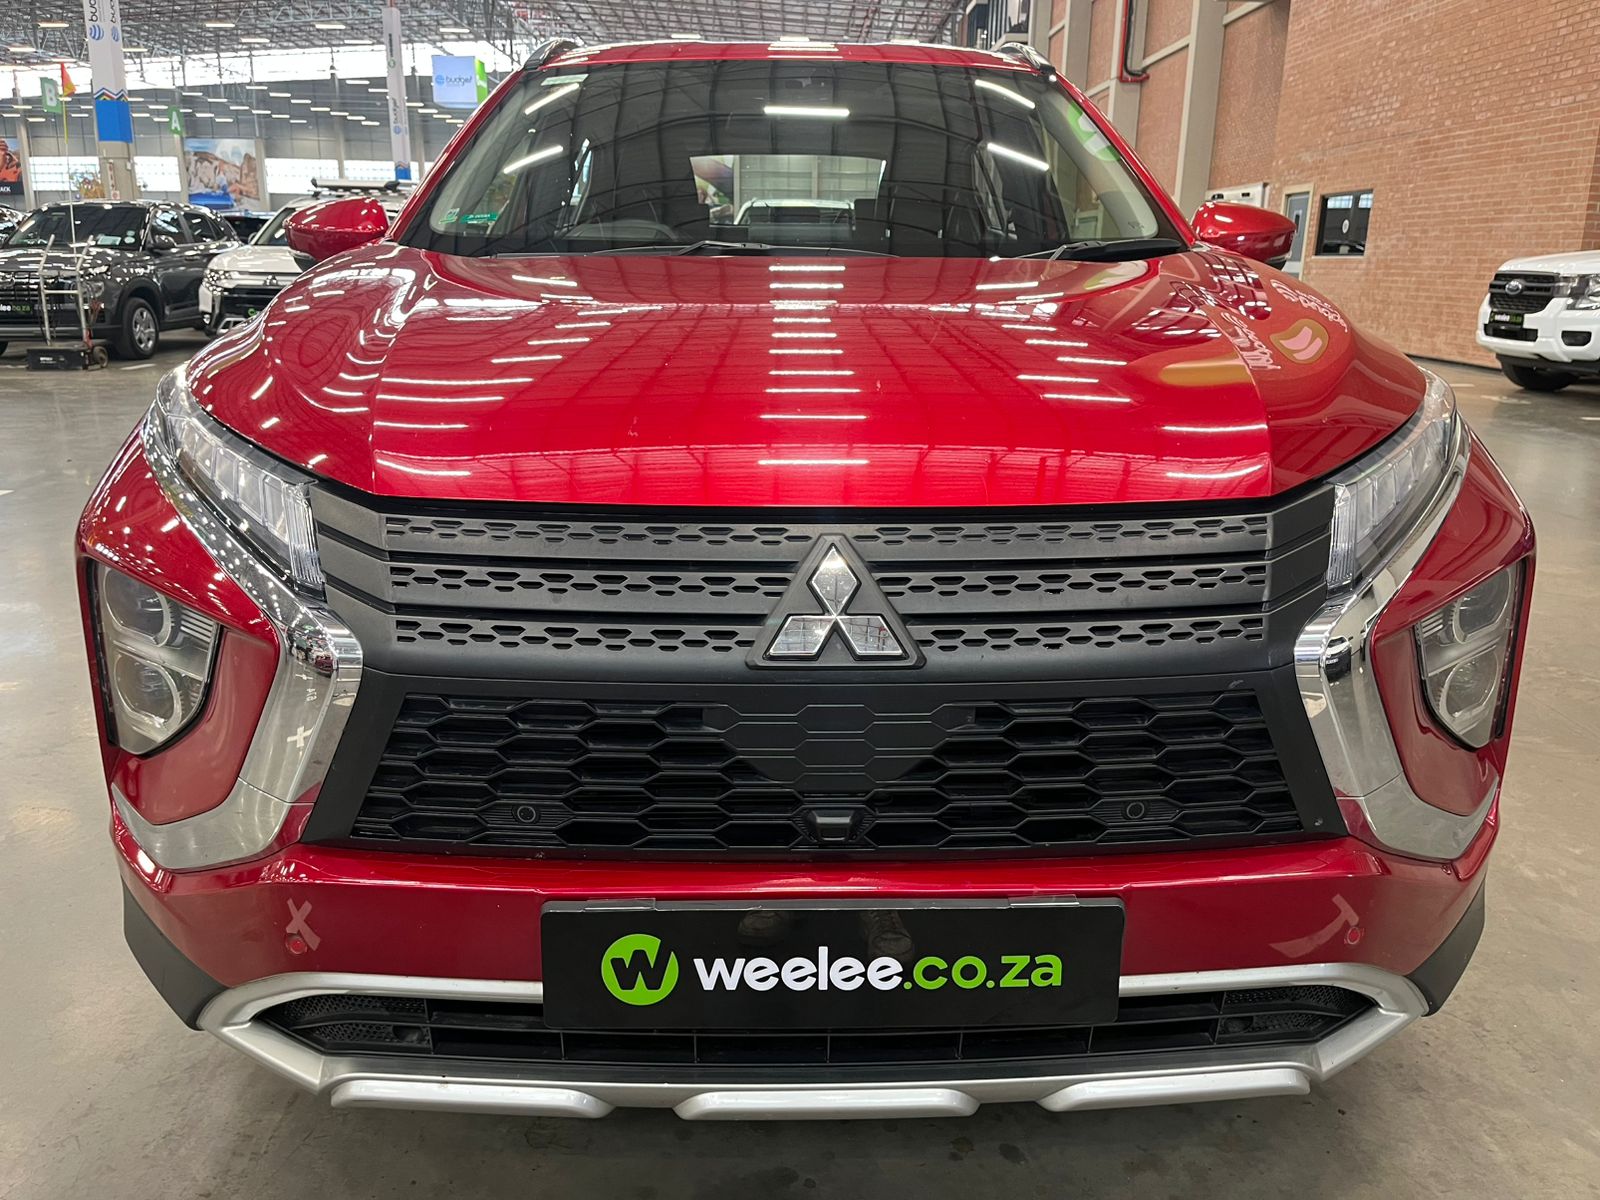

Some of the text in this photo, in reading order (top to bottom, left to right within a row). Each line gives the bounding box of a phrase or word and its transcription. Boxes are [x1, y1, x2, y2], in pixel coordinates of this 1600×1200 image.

[446, 75, 472, 87] budget
[45, 82, 57, 106] B
[171, 111, 181, 131] A
[693, 945, 1062, 990] weelee.co.za
